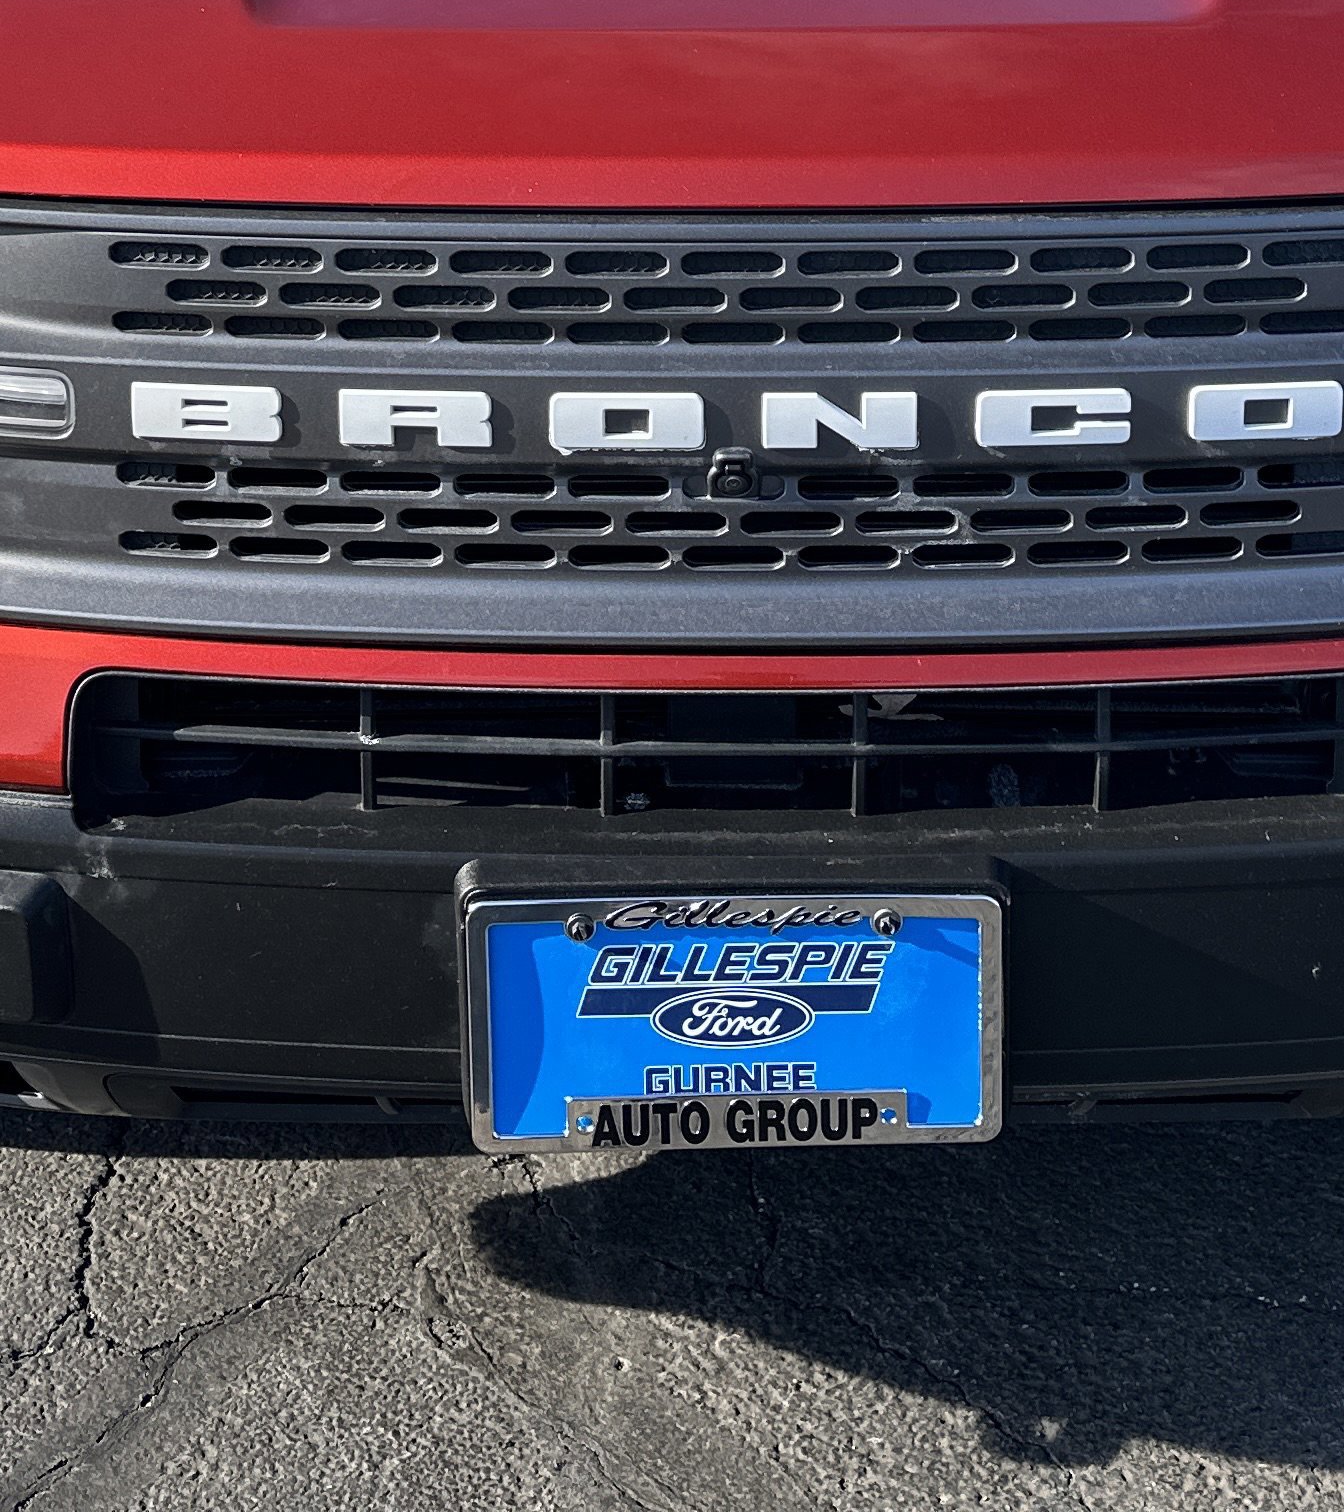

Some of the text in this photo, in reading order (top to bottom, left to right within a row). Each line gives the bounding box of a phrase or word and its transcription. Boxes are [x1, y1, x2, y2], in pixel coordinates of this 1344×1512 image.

[605, 899, 861, 936] Gillespie
[587, 941, 895, 986] GILLESPIE
[681, 997, 784, 1037] Ford
[643, 1061, 817, 1094] GURNEE
[591, 1096, 879, 1148] AUTO GROUP
